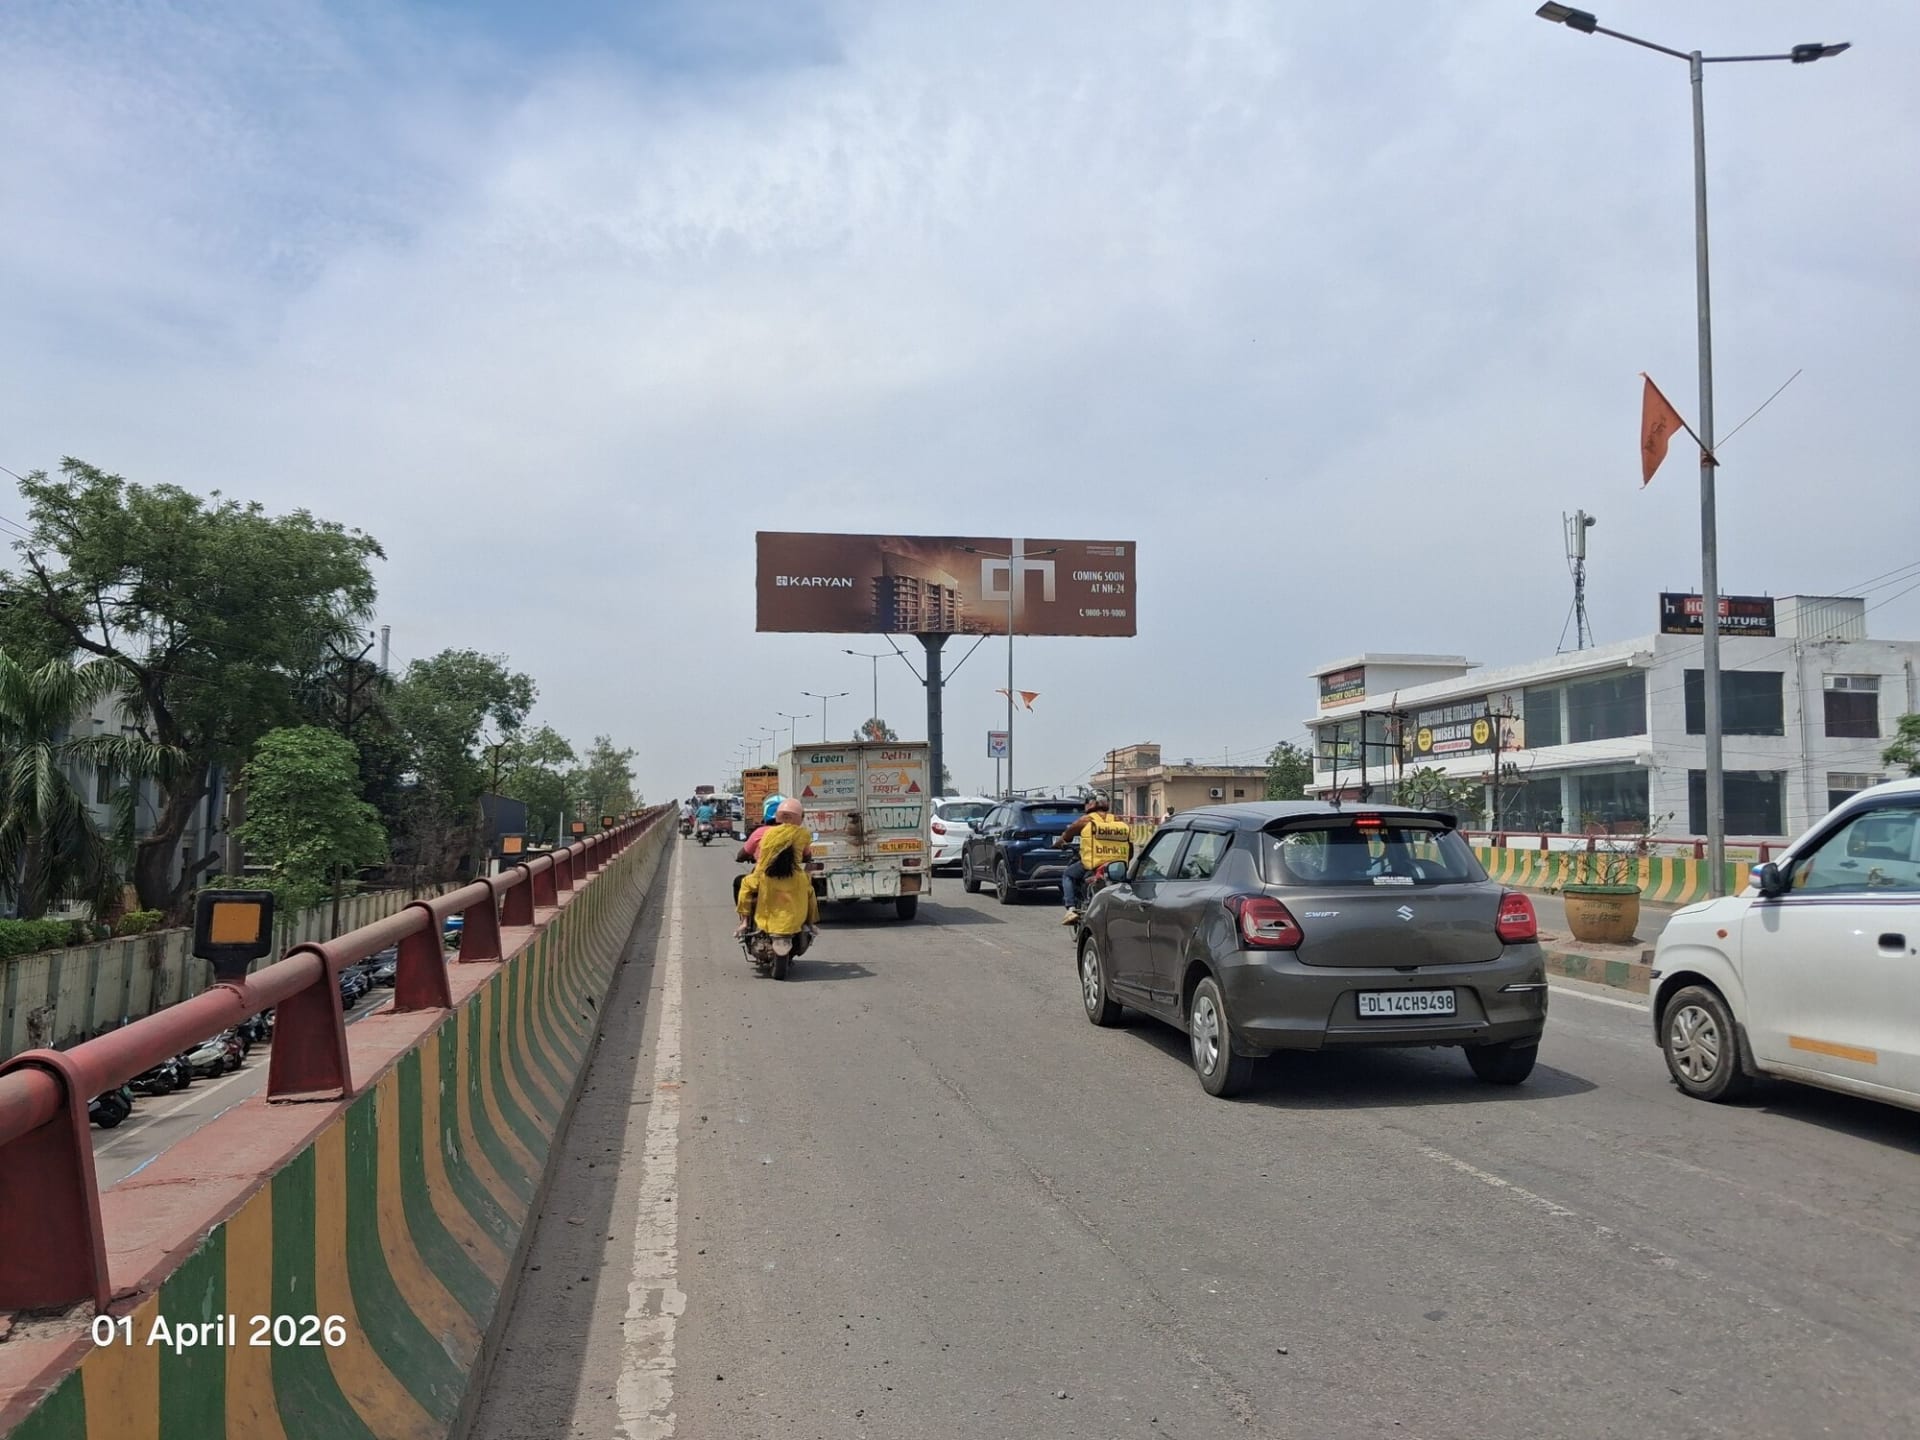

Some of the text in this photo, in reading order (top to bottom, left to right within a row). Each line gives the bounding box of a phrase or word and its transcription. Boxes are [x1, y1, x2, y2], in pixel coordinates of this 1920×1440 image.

[790, 576, 853, 587] KARYAN
[1073, 571, 1124, 581] COMING SOON
[1091, 584, 1124, 593] AT NH-24
[1686, 600, 1726, 614] HOE
[1690, 615, 1768, 626] FUNITURE
[1344, 688, 1364, 698] OUTLET
[1432, 726, 1455, 742] UNISEX
[1456, 723, 1472, 738] GYM
[811, 753, 844, 763] Green
[868, 805, 922, 829] HORN
[1097, 825, 1127, 836] blinkit
[1095, 845, 1127, 856] blinkit
[1368, 995, 1453, 1012] DL14CH9498
